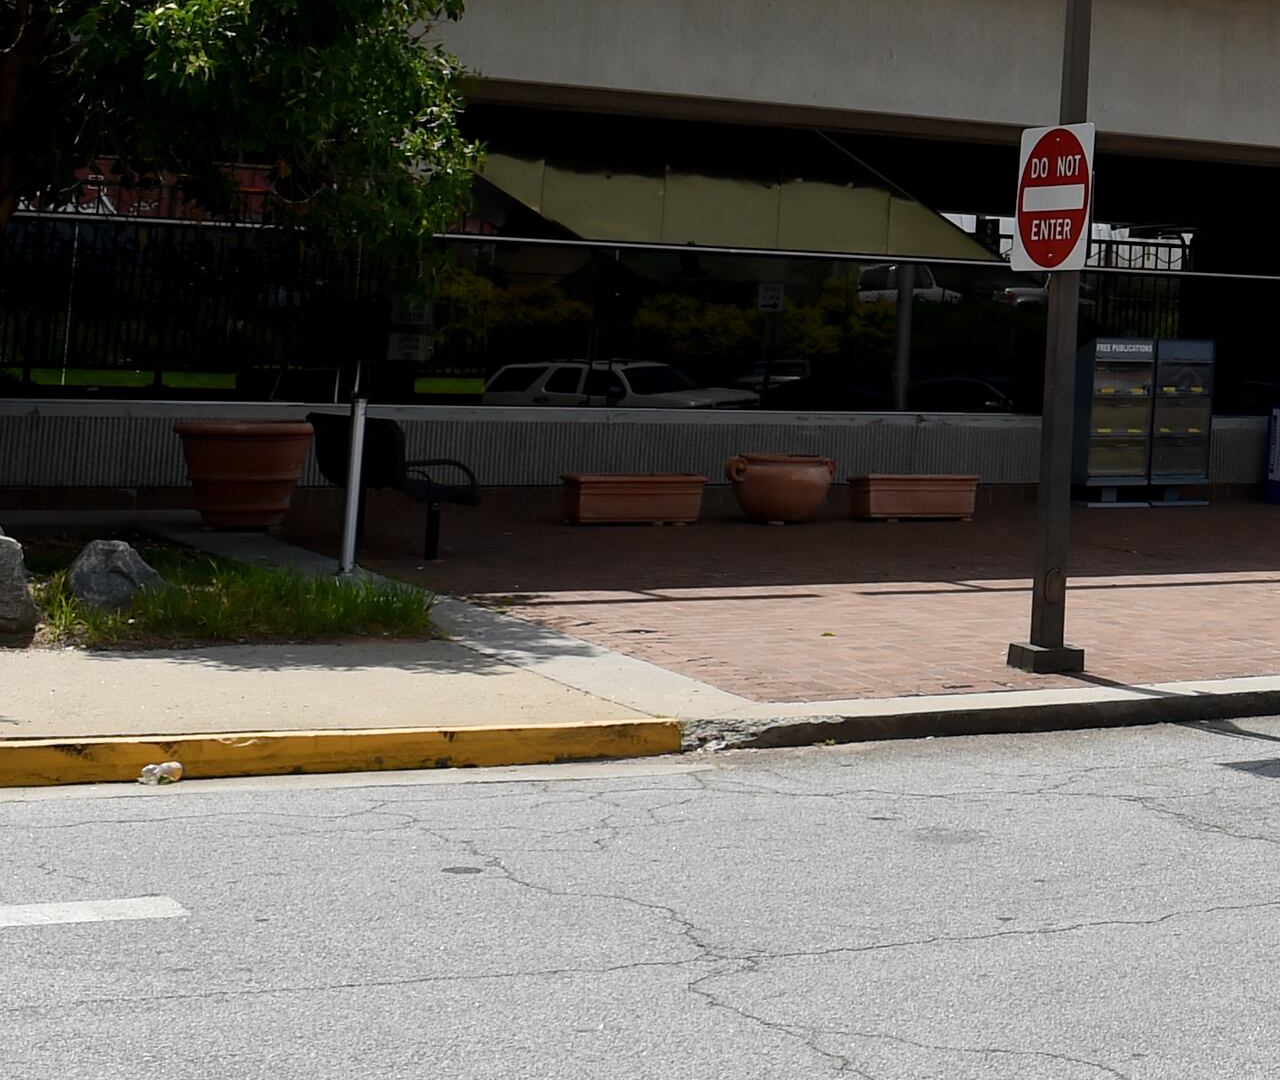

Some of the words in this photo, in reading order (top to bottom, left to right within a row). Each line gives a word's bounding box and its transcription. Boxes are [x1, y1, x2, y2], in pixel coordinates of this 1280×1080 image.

[1031, 157, 1048, 179] DO
[1057, 155, 1081, 177] NOT
[1030, 219, 1072, 241] ENTER
[1096, 343, 1111, 352] FREE
[1112, 343, 1153, 353] PUBLICATIONS
